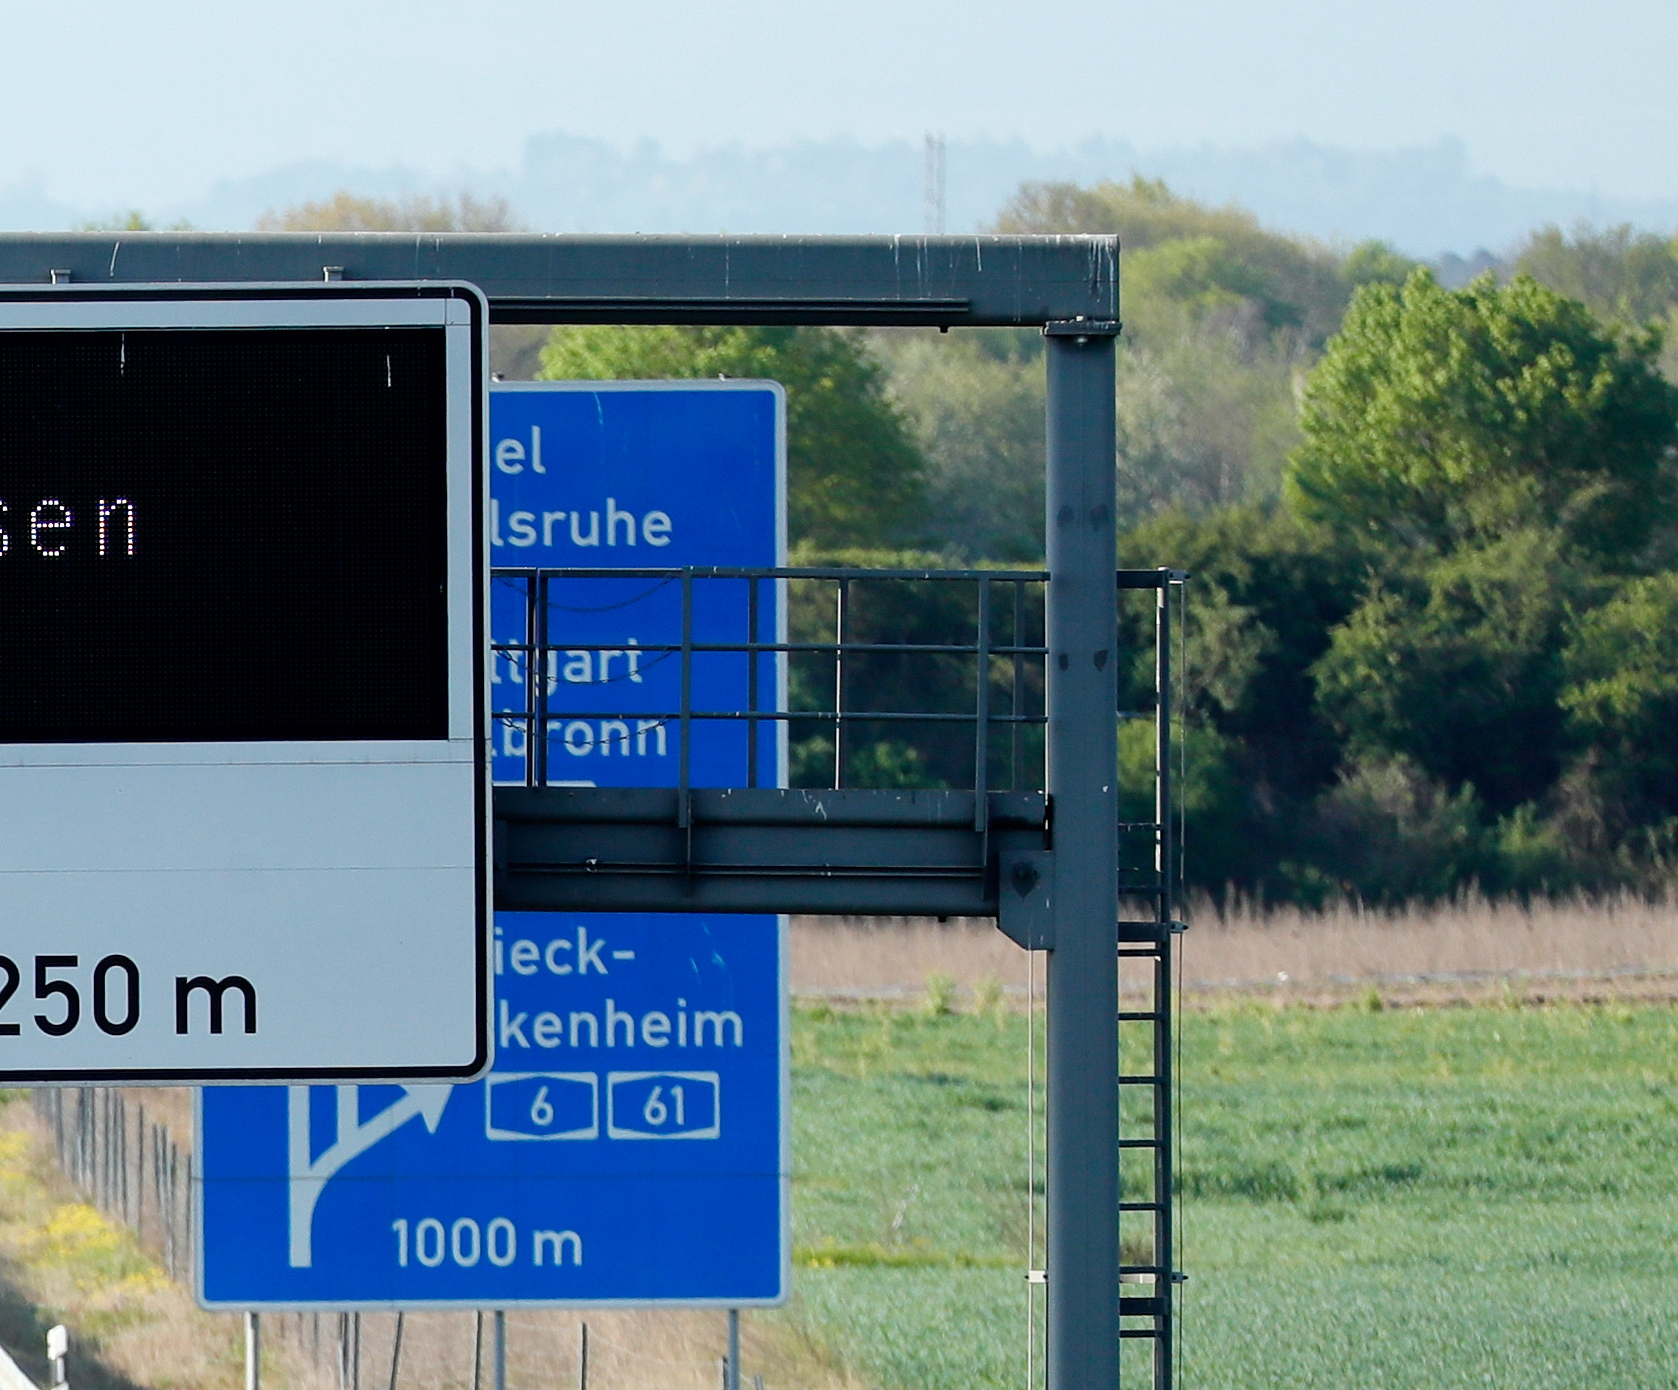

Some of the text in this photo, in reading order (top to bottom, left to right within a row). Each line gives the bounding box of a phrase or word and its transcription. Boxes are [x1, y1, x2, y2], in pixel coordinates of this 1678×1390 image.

[495, 425, 547, 475] el
[494, 926, 636, 976] ieck-
[174, 974, 258, 1036] m
[499, 997, 744, 1049] kenheim
[530, 1085, 554, 1126] 6
[643, 1085, 685, 1126] 61
[391, 1217, 584, 1268] 1000 m
